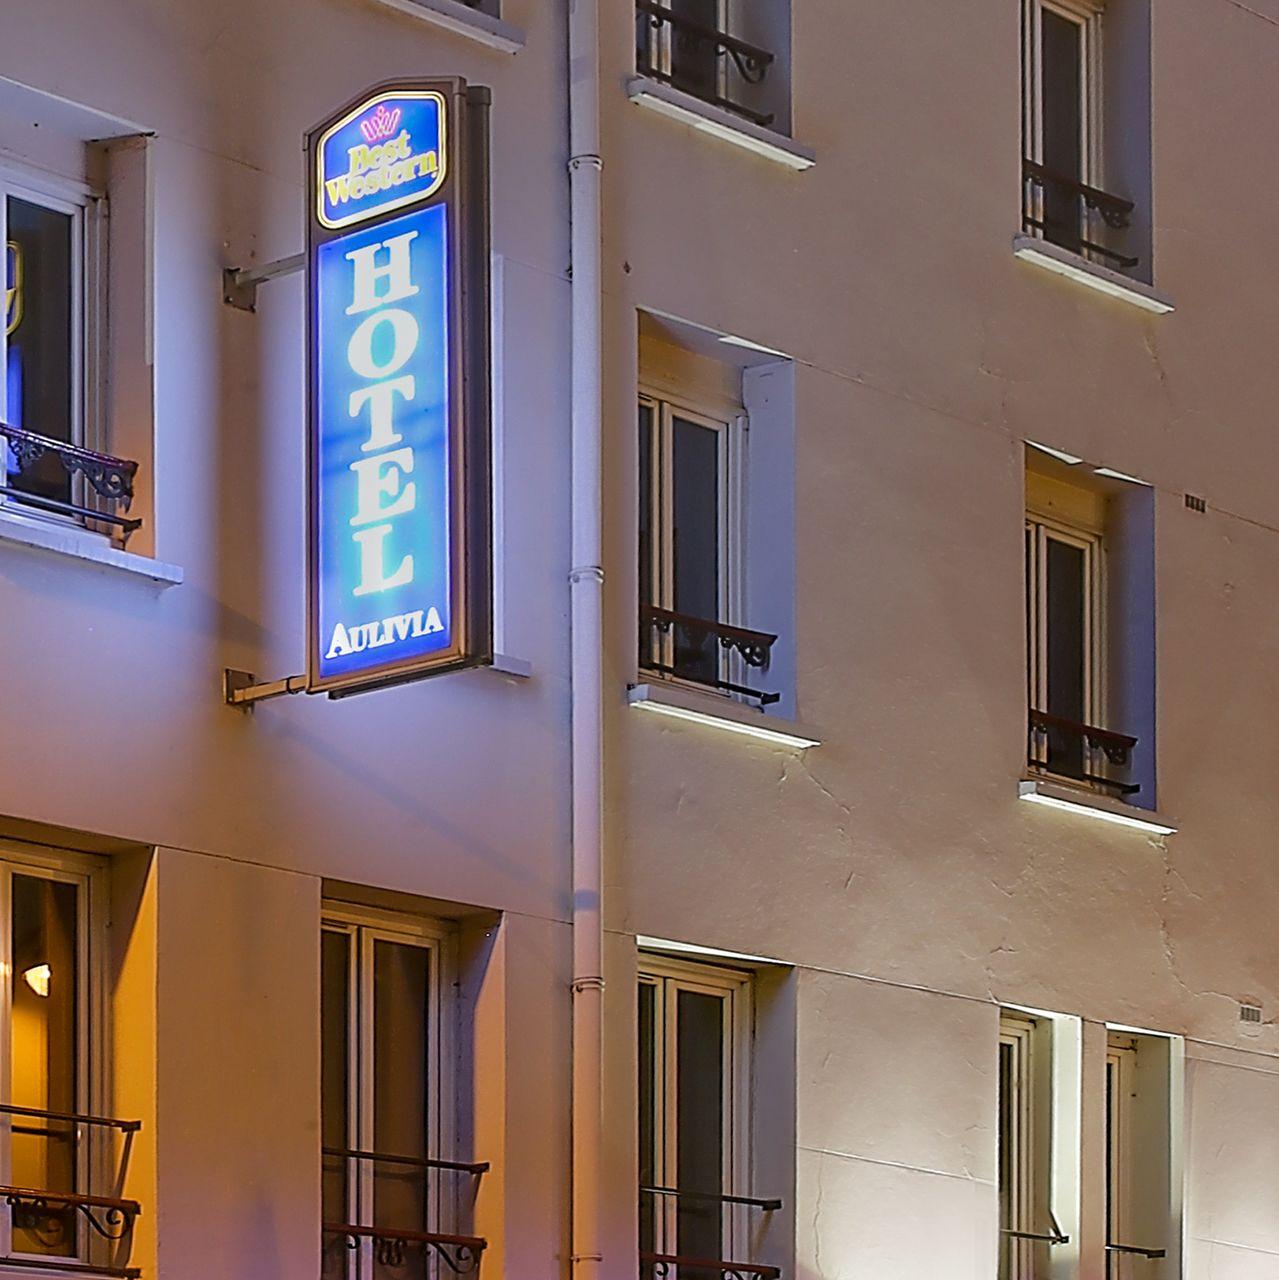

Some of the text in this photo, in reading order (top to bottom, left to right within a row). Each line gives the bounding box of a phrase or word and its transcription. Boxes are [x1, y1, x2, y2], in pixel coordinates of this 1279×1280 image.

[325, 151, 438, 206] Western
[347, 129, 411, 175] Best
[345, 231, 419, 596] HOTEL
